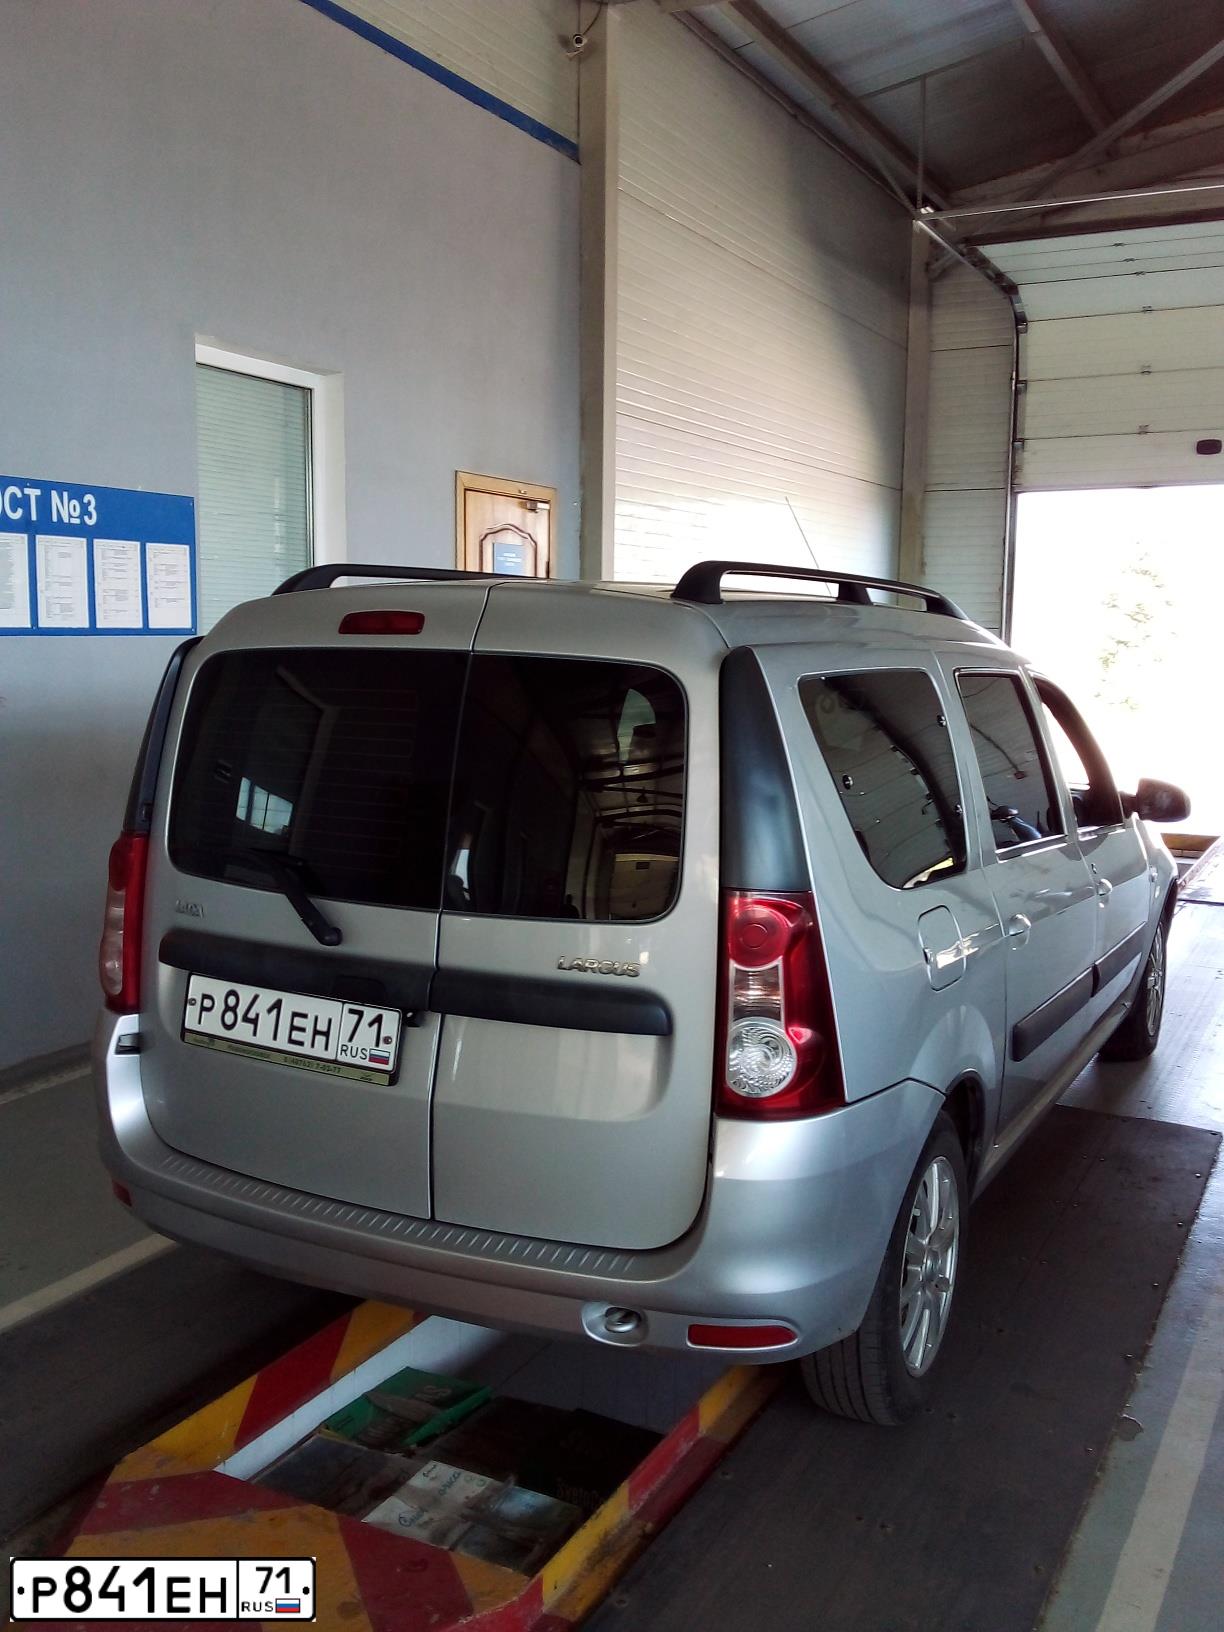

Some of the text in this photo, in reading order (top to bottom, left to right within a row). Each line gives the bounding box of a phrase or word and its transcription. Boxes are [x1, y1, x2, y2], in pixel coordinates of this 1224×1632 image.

[0, 485, 41, 521] СТ
[347, 1008, 385, 1047] 71
[340, 1044, 368, 1060] RUS
